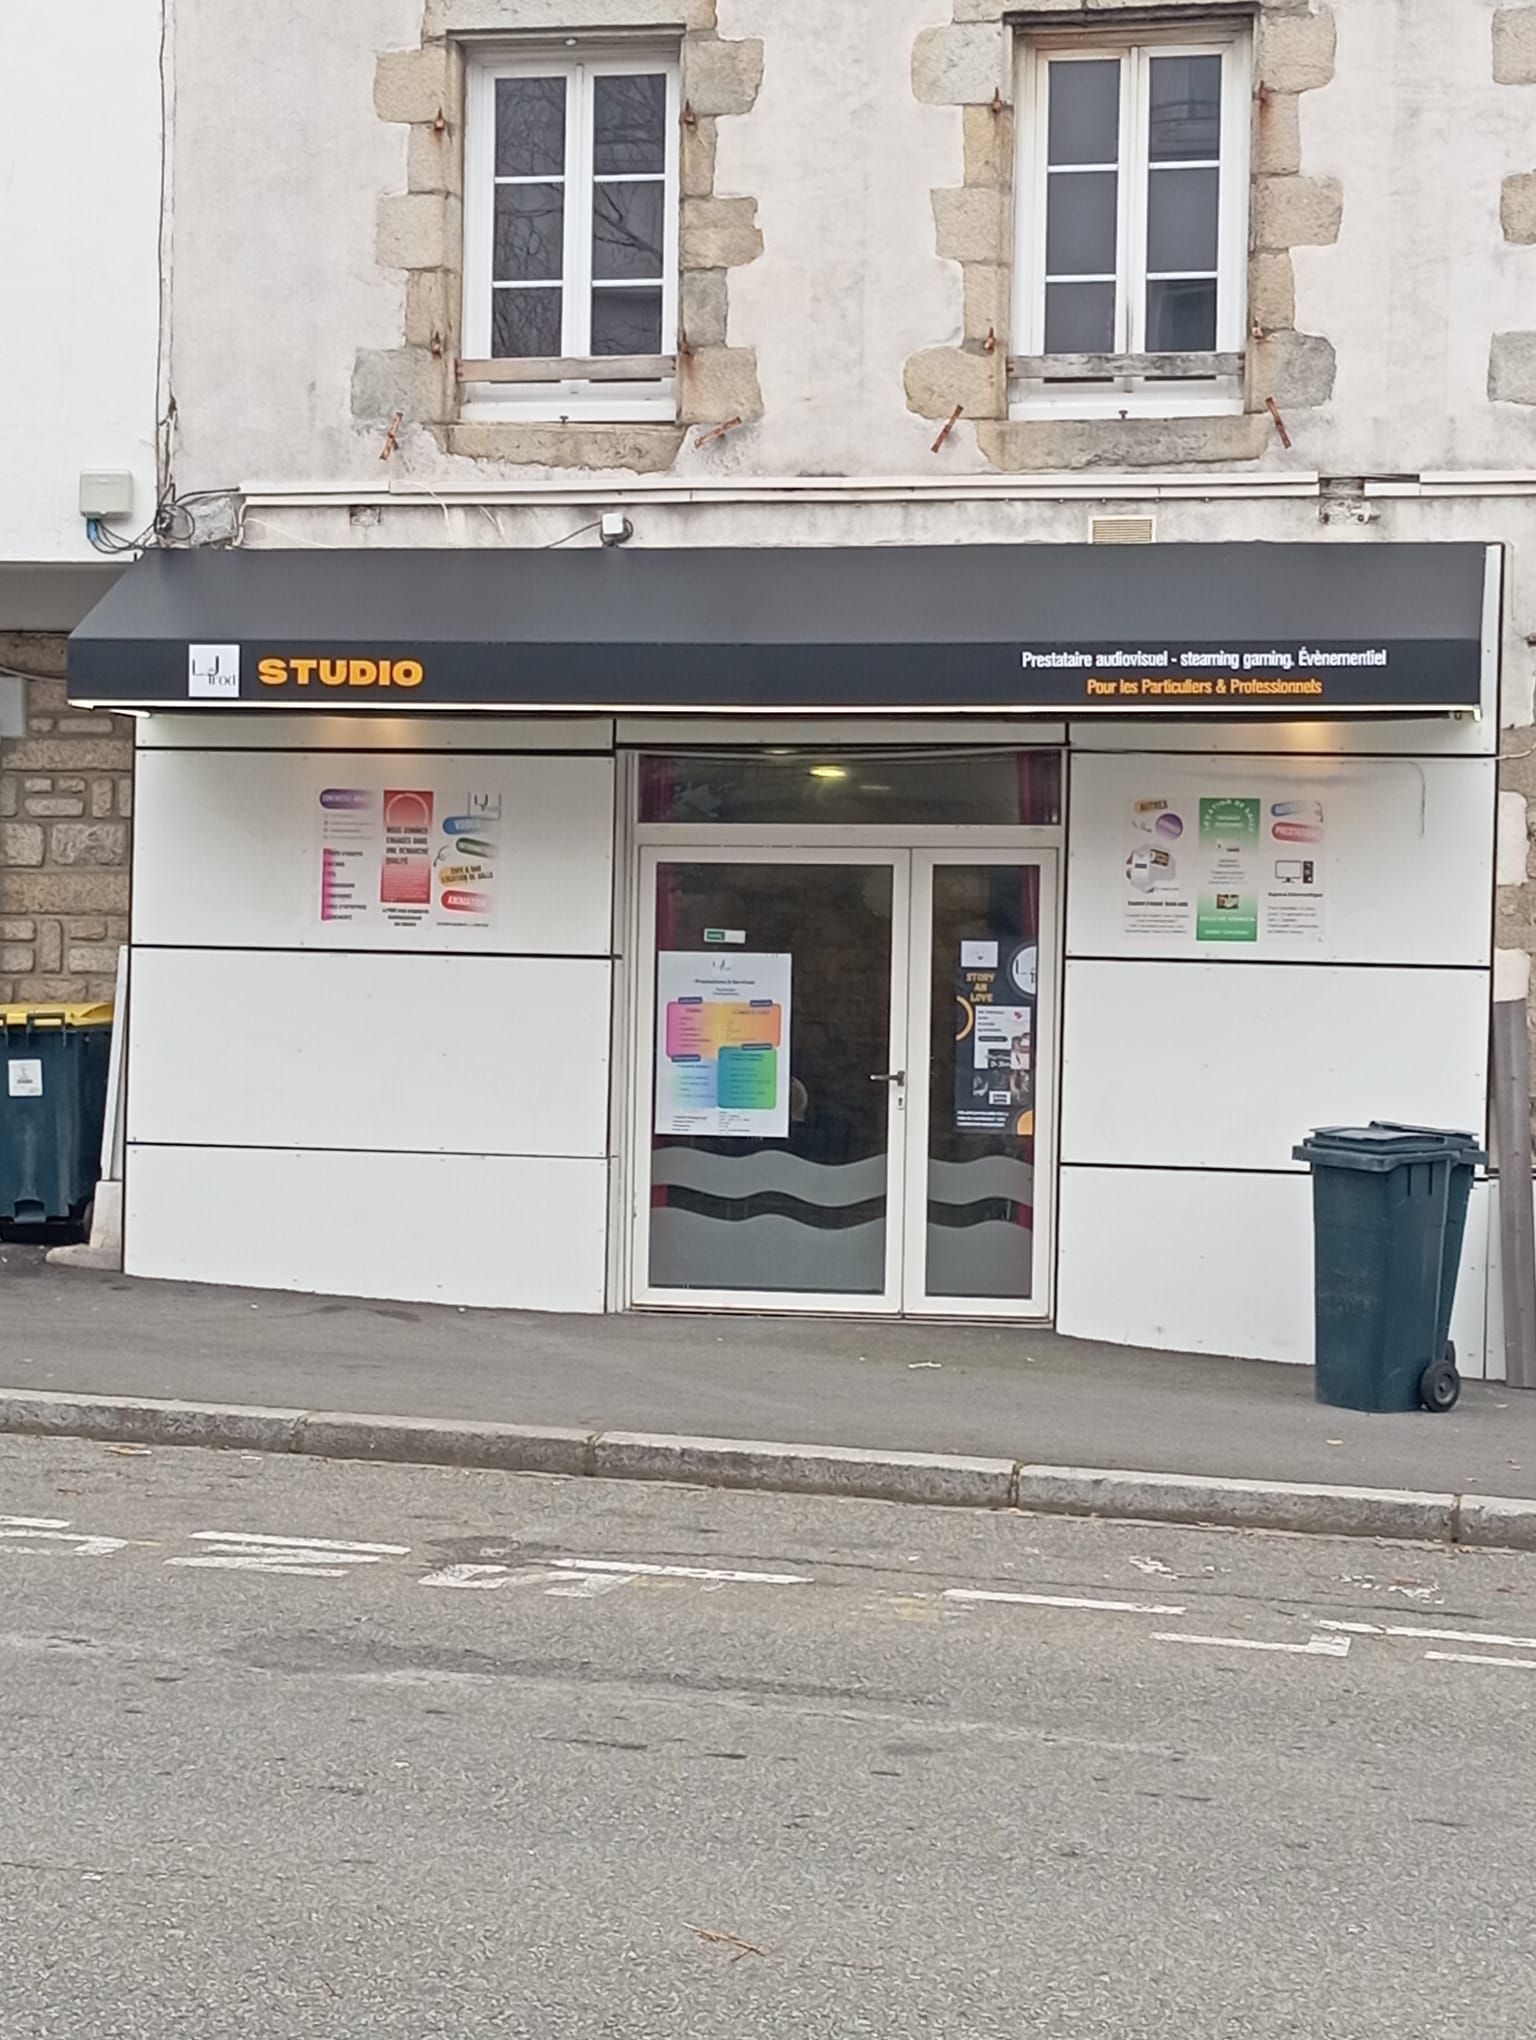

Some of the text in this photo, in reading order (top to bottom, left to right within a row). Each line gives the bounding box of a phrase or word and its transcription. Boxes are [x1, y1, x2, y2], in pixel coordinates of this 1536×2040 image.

[1022, 651, 1092, 667] Prestataire
[1096, 650, 1168, 667] audiovisuel
[1180, 651, 1239, 671] steaming
[257, 659, 424, 686] STUDIO
[1087, 678, 1322, 694] Pour les Particuliers & Professionnels
